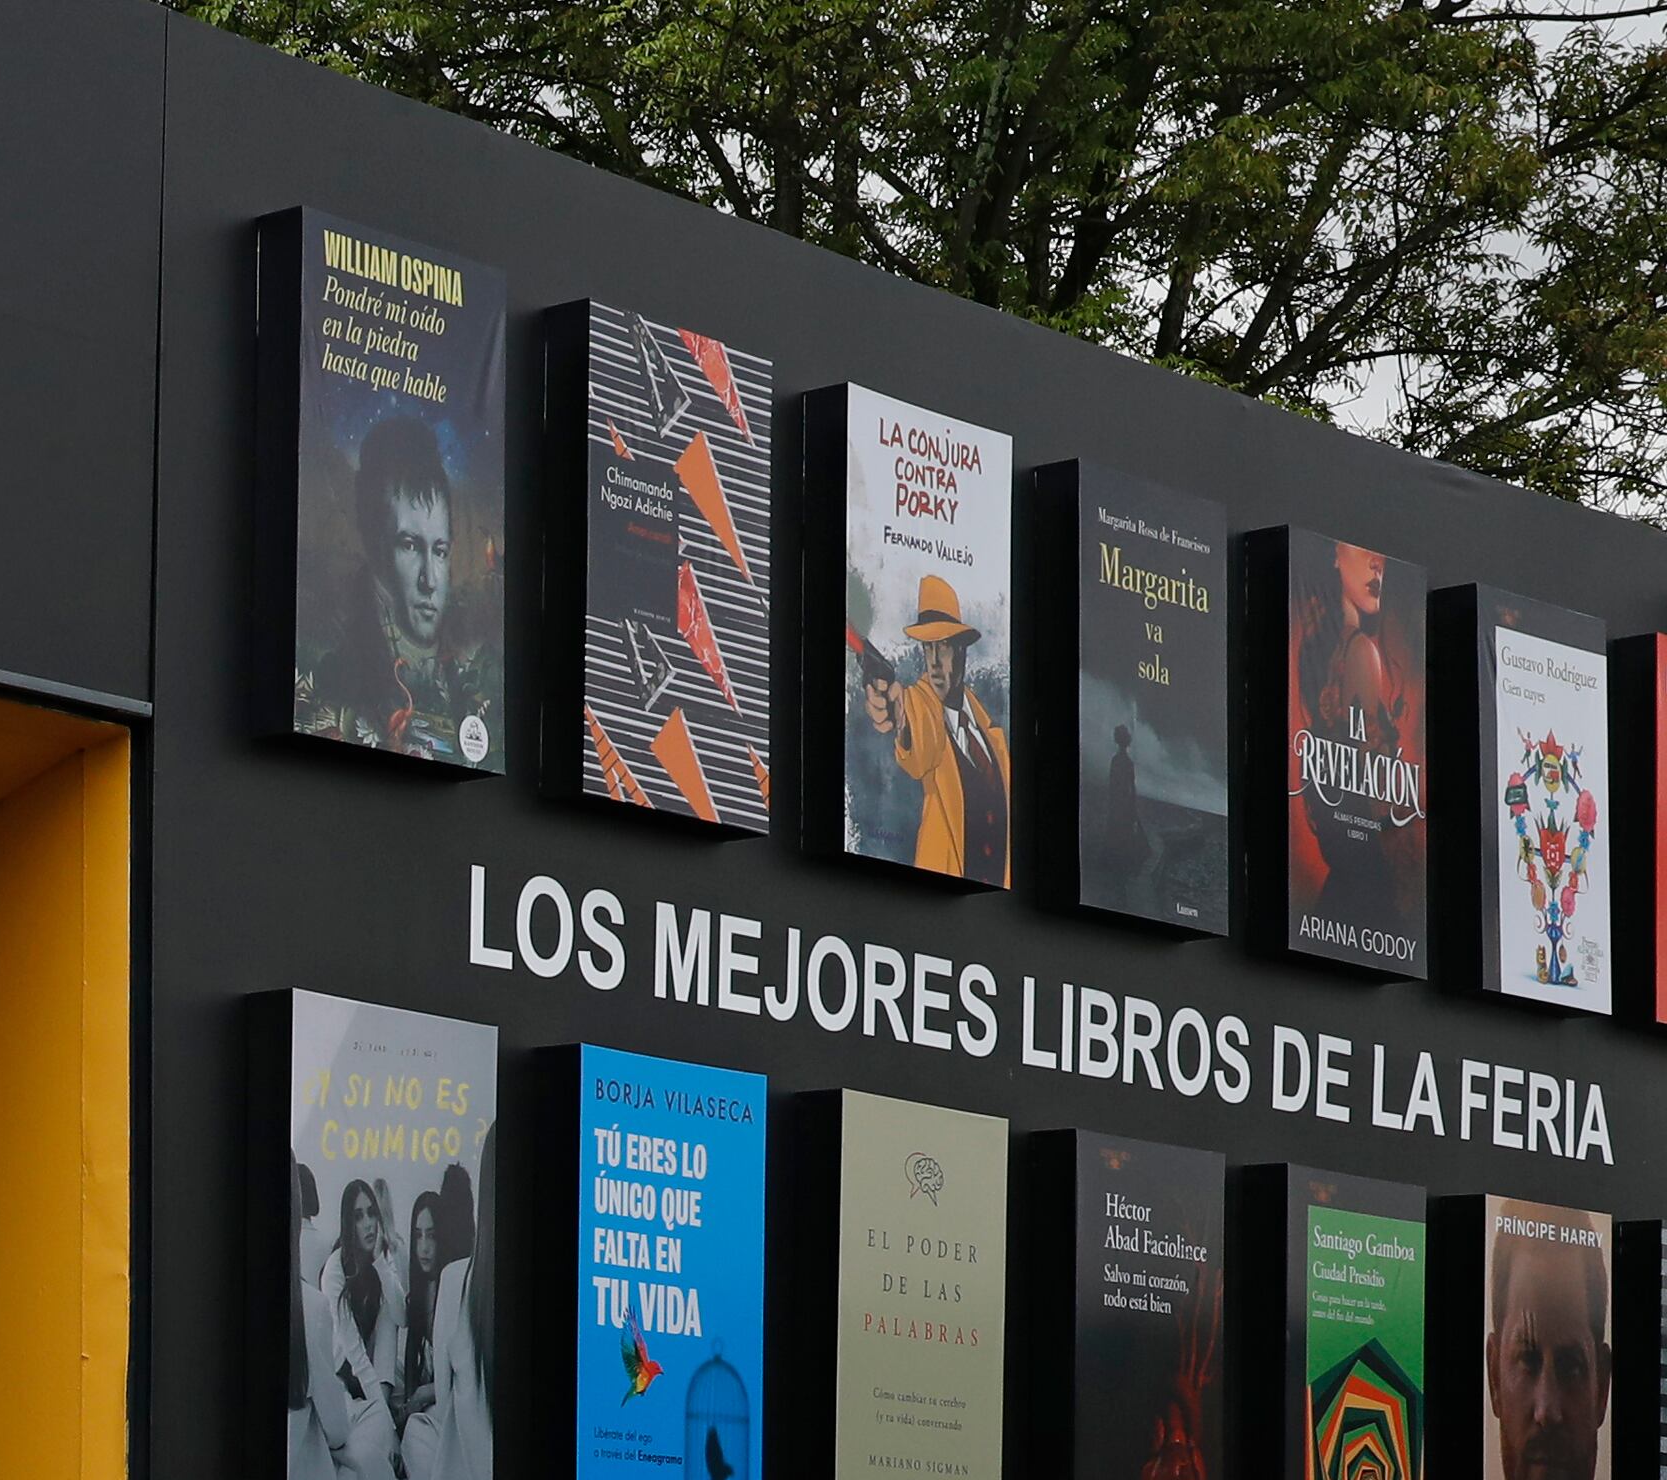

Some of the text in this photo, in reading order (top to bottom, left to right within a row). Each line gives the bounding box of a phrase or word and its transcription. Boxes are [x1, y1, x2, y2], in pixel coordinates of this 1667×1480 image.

[323, 229, 463, 307] WILLIAM OSPINA
[323, 275, 446, 336] Pondré mi oído
[323, 317, 418, 362] en la piedra
[322, 344, 447, 404] hasta que hable
[879, 418, 903, 448] LA
[606, 466, 673, 501] Chimamanda
[895, 457, 957, 494] CONTRA
[601, 485, 673, 523] Ngozi Adichie
[896, 483, 959, 525] PORKY
[1099, 543, 1210, 614] Margarita
[1145, 621, 1163, 645] va
[1138, 653, 1170, 686] sola
[1501, 646, 1598, 692] Gustavo Rodríguez
[1348, 706, 1366, 743] LA
[1289, 729, 1426, 827] REVELACIÓN
[1299, 913, 1416, 962] ARIANA GODOY
[469, 864, 1615, 1167] LOS MEJORES LIBROS DE LA FERIA
[595, 1078, 753, 1124] BORJA VILASECA
[594, 1122, 707, 1180] TÚ ERES LO
[594, 1168, 702, 1232] ÚNICO QUE
[1105, 1193, 1151, 1223] Héctor
[594, 1227, 682, 1274] FALTA EN
[867, 1228, 978, 1264] EL PODER
[1104, 1225, 1207, 1263] Abad Faciolince
[1314, 1226, 1415, 1262] Santiago Gamboa
[1495, 1214, 1603, 1248] PRÍNCIPE HARRY
[592, 1275, 702, 1338] TU VIDA
[883, 1273, 963, 1303] DE LAS
[864, 1313, 980, 1347] PALABRAS
